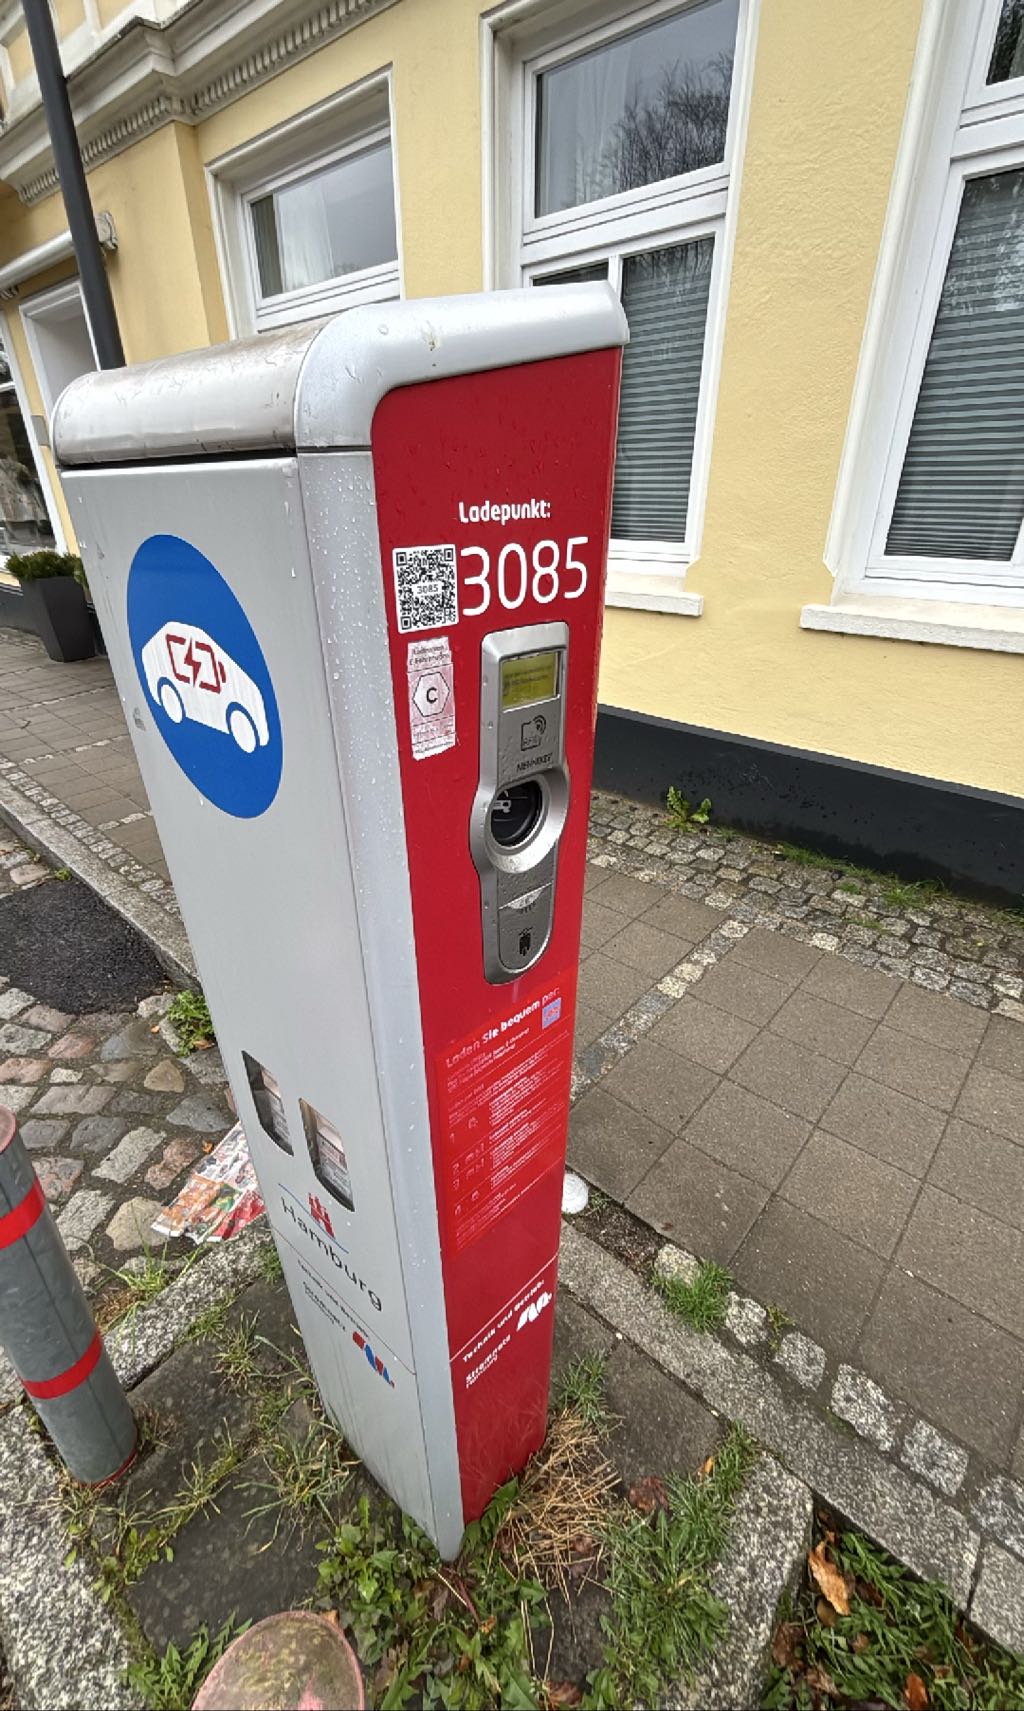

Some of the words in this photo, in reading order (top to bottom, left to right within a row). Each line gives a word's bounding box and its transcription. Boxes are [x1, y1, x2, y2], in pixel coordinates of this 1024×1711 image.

[458, 499, 551, 525] Ladepunkt:
[417, 584, 439, 594] 3085
[460, 536, 589, 616] 3085
[426, 687, 438, 703] C
[446, 1041, 480, 1068] Laden
[482, 1028, 499, 1044] Sie
[500, 1000, 540, 1032] bequem
[281, 1196, 382, 1311] Hamburg
